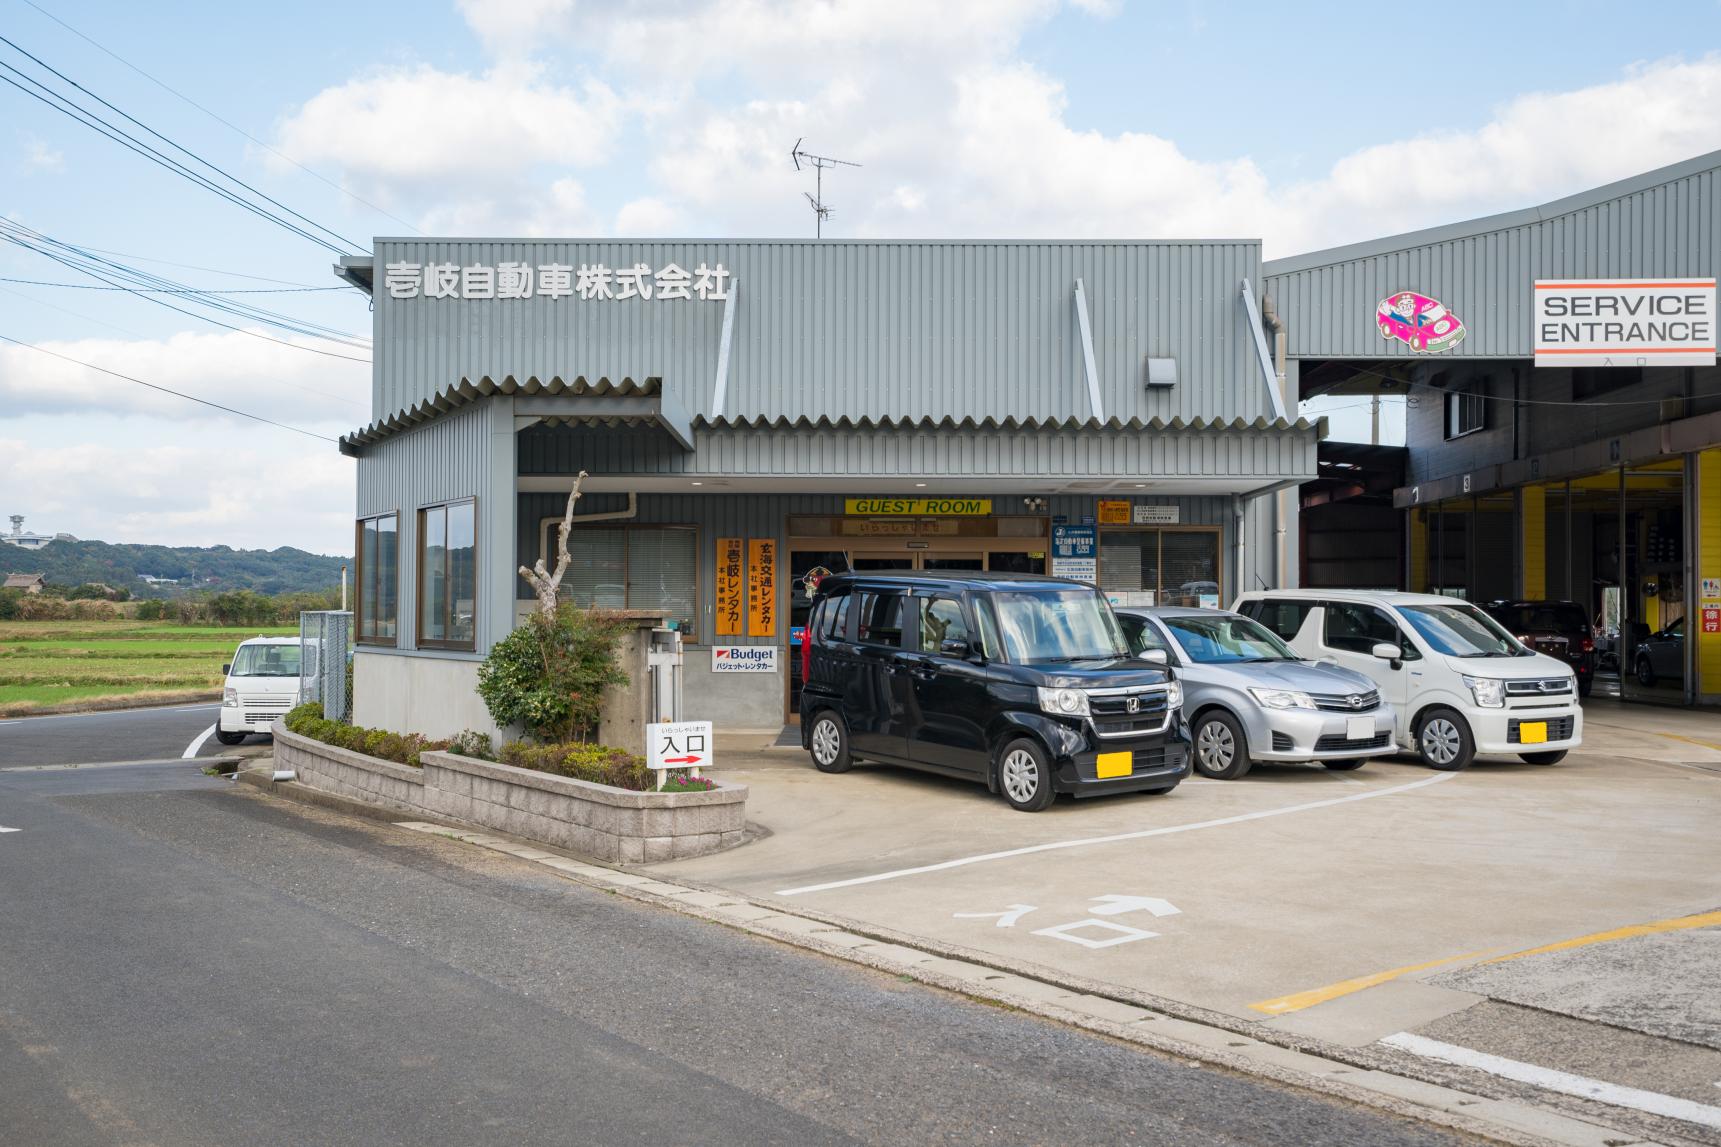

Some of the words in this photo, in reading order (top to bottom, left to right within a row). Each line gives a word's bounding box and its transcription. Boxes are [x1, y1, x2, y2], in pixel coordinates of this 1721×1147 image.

[385, 260, 731, 301] 壱岐自動車株式会社
[1544, 295, 1707, 316] SERVICE
[1541, 321, 1710, 342] ENTRANCE
[856, 500, 916, 513] GUEST
[926, 500, 981, 513] ROOM
[760, 543, 773, 632] 玄海交通レンタカー
[1705, 610, 1718, 631] 徐行
[731, 648, 773, 662] Budget
[661, 725, 706, 734] いらっしゃいませ
[660, 735, 705, 755] 入口
